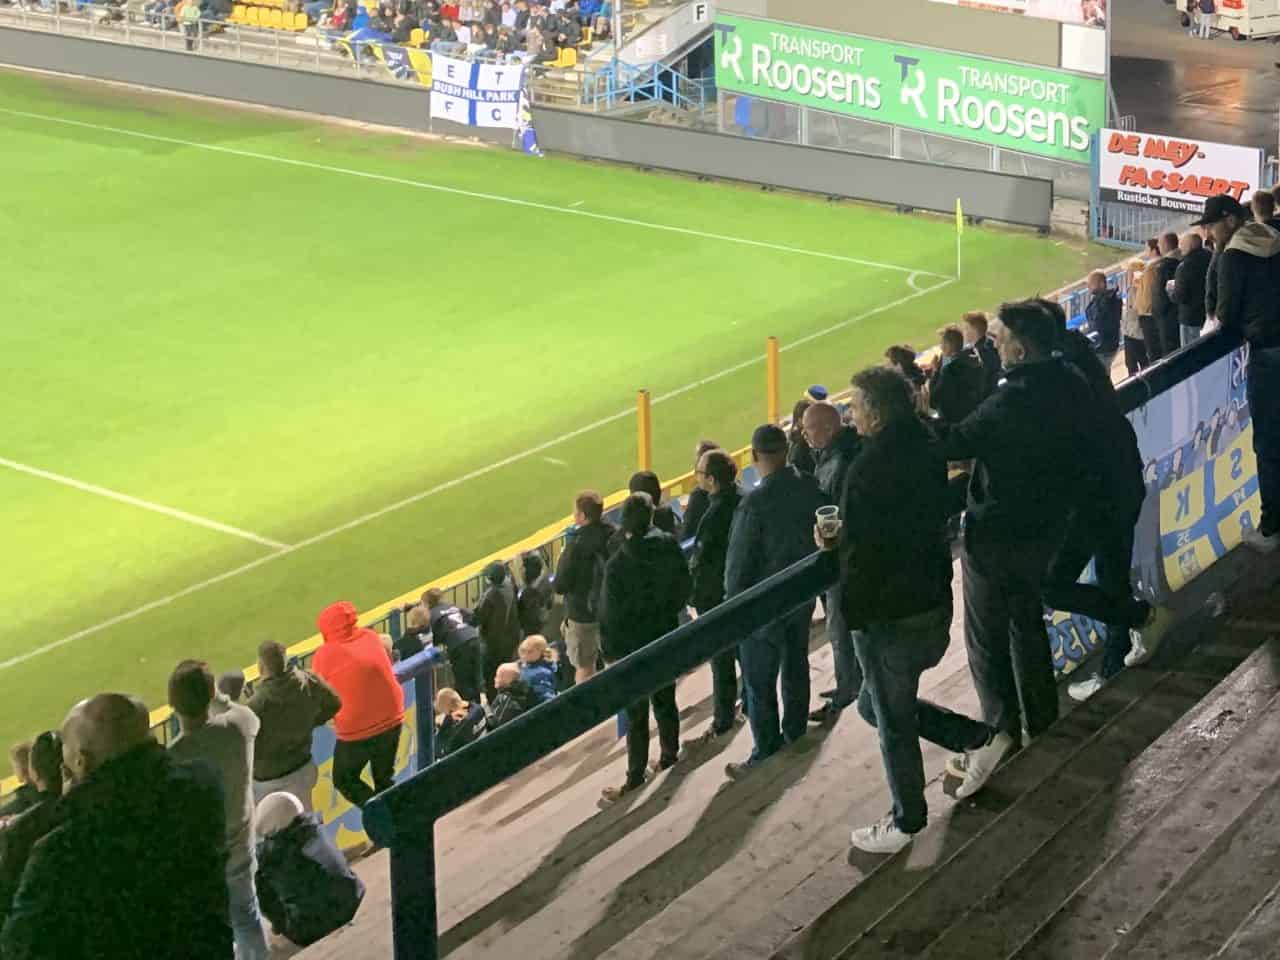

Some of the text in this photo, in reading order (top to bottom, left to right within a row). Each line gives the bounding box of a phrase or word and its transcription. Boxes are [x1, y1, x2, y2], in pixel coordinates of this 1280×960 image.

[696, 4, 705, 21] F
[770, 31, 865, 68] TRANSPORT
[447, 65, 504, 85] E T
[751, 44, 882, 110] Roosens
[958, 65, 1070, 105] TRANSPORT
[486, 90, 516, 102] PARK
[445, 101, 501, 121] F C
[937, 79, 1091, 152] Roosens
[1107, 132, 1142, 157] DE
[1118, 165, 1250, 202] FASSAERT
[1117, 191, 1159, 206] Rustieke
